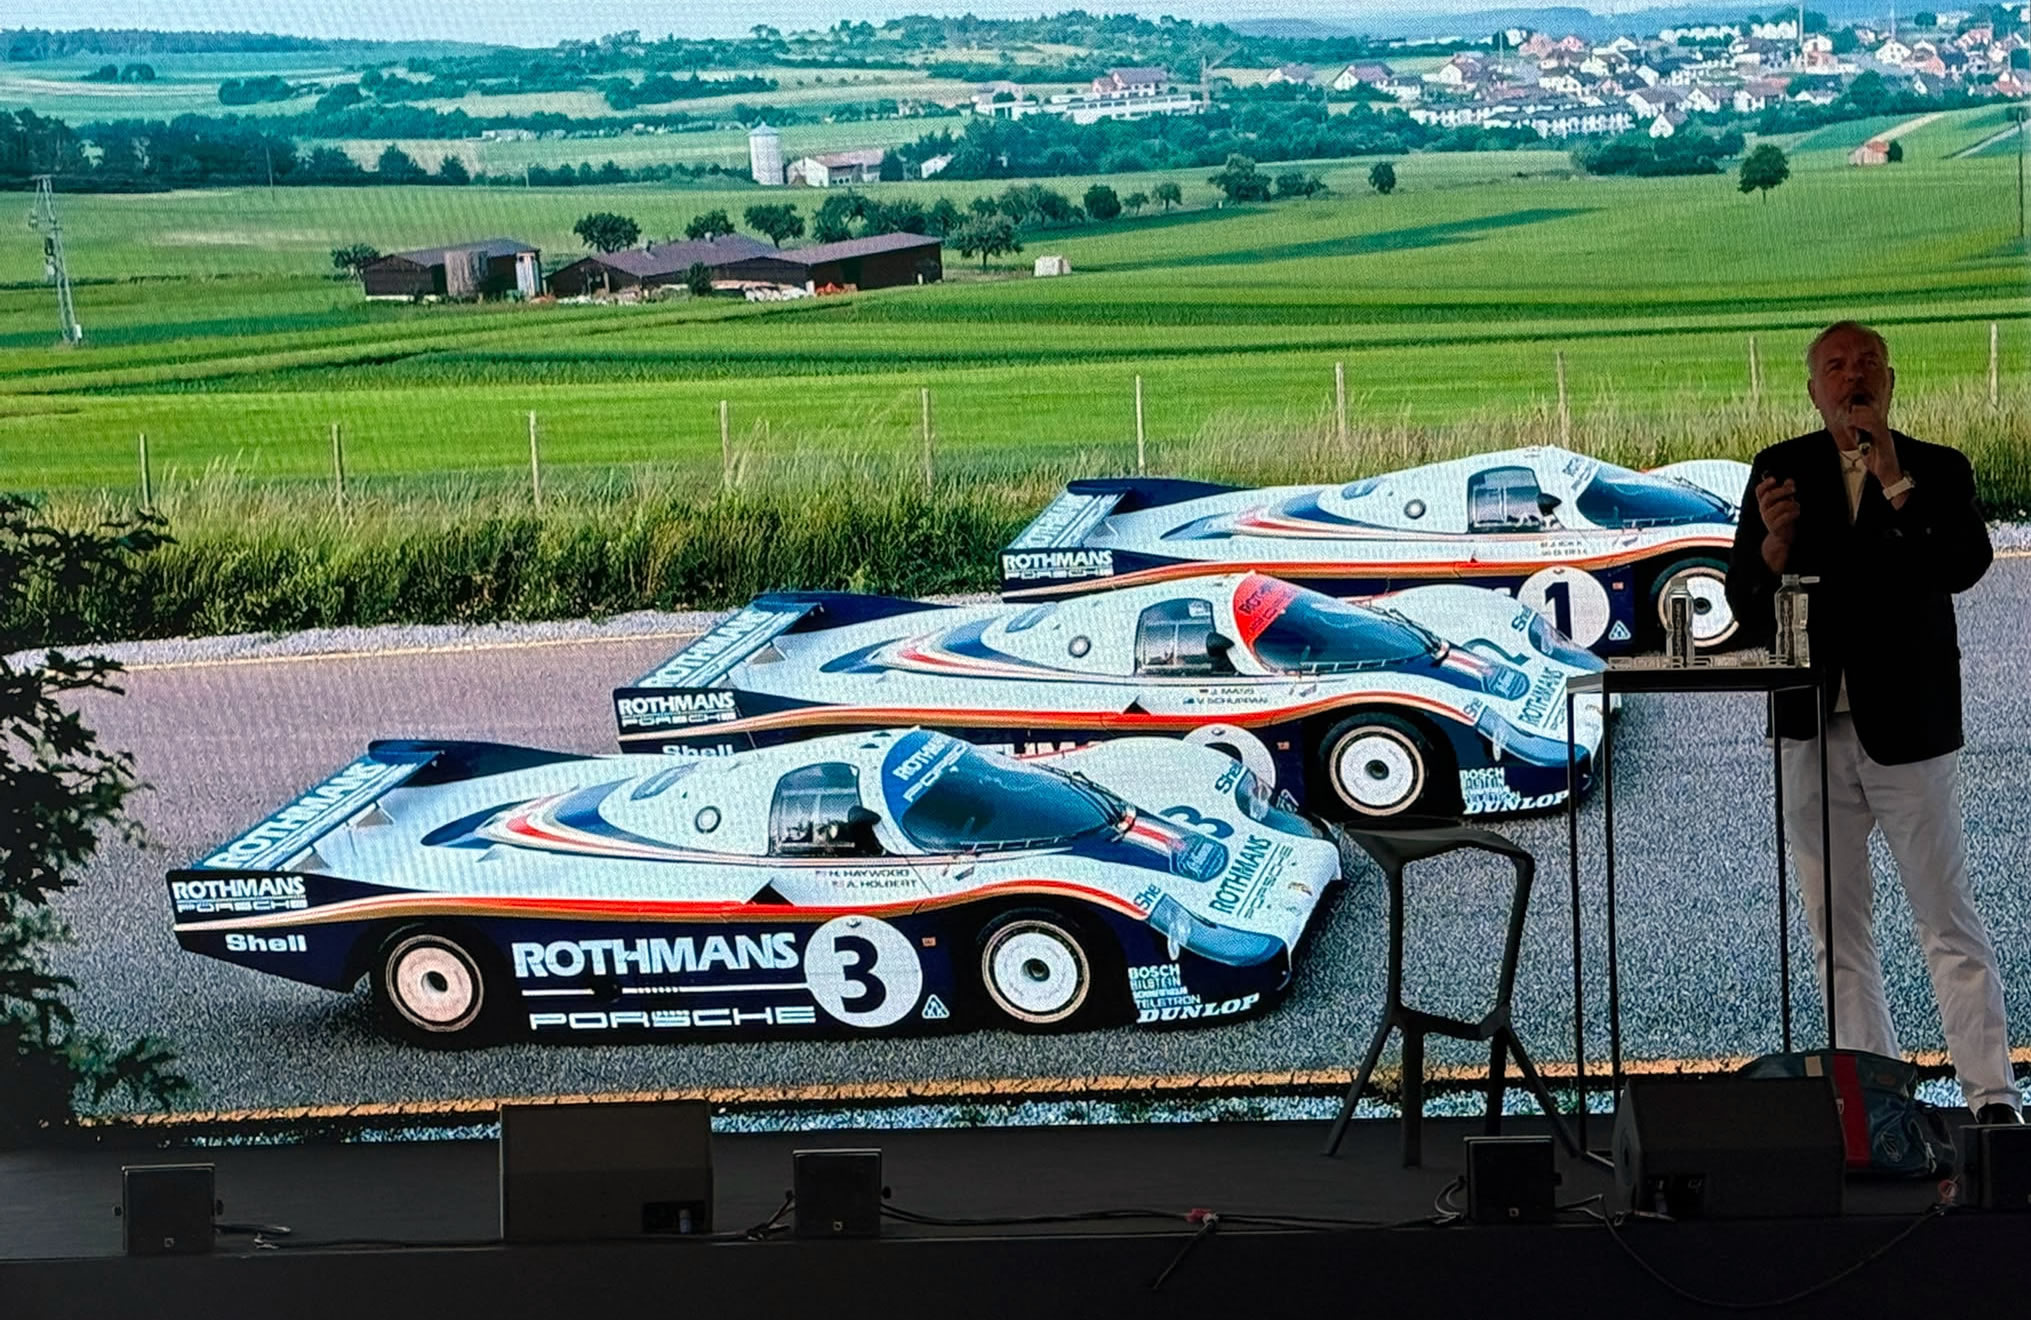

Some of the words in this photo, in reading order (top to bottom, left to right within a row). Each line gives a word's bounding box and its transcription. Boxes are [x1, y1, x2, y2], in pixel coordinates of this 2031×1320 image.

[1002, 550, 1113, 570] ROTHMANS
[1544, 581, 1573, 641] 1
[617, 691, 736, 716] ROTHMANS
[1463, 789, 1569, 815] DUNLOP
[203, 762, 388, 869] ROTHMANS
[1208, 835, 1272, 914] ROTHMANS
[1244, 845, 1293, 919] PORSCHE
[171, 876, 306, 900] ROTHMANS
[177, 898, 309, 913] PORSCHE
[224, 933, 307, 952] Shell
[511, 932, 800, 978] ROTHMANS
[834, 935, 887, 1014] 3
[1128, 963, 1180, 979] BOSCH
[529, 1005, 817, 1030] PORSCHE
[1136, 992, 1260, 1023] DUNLOP
